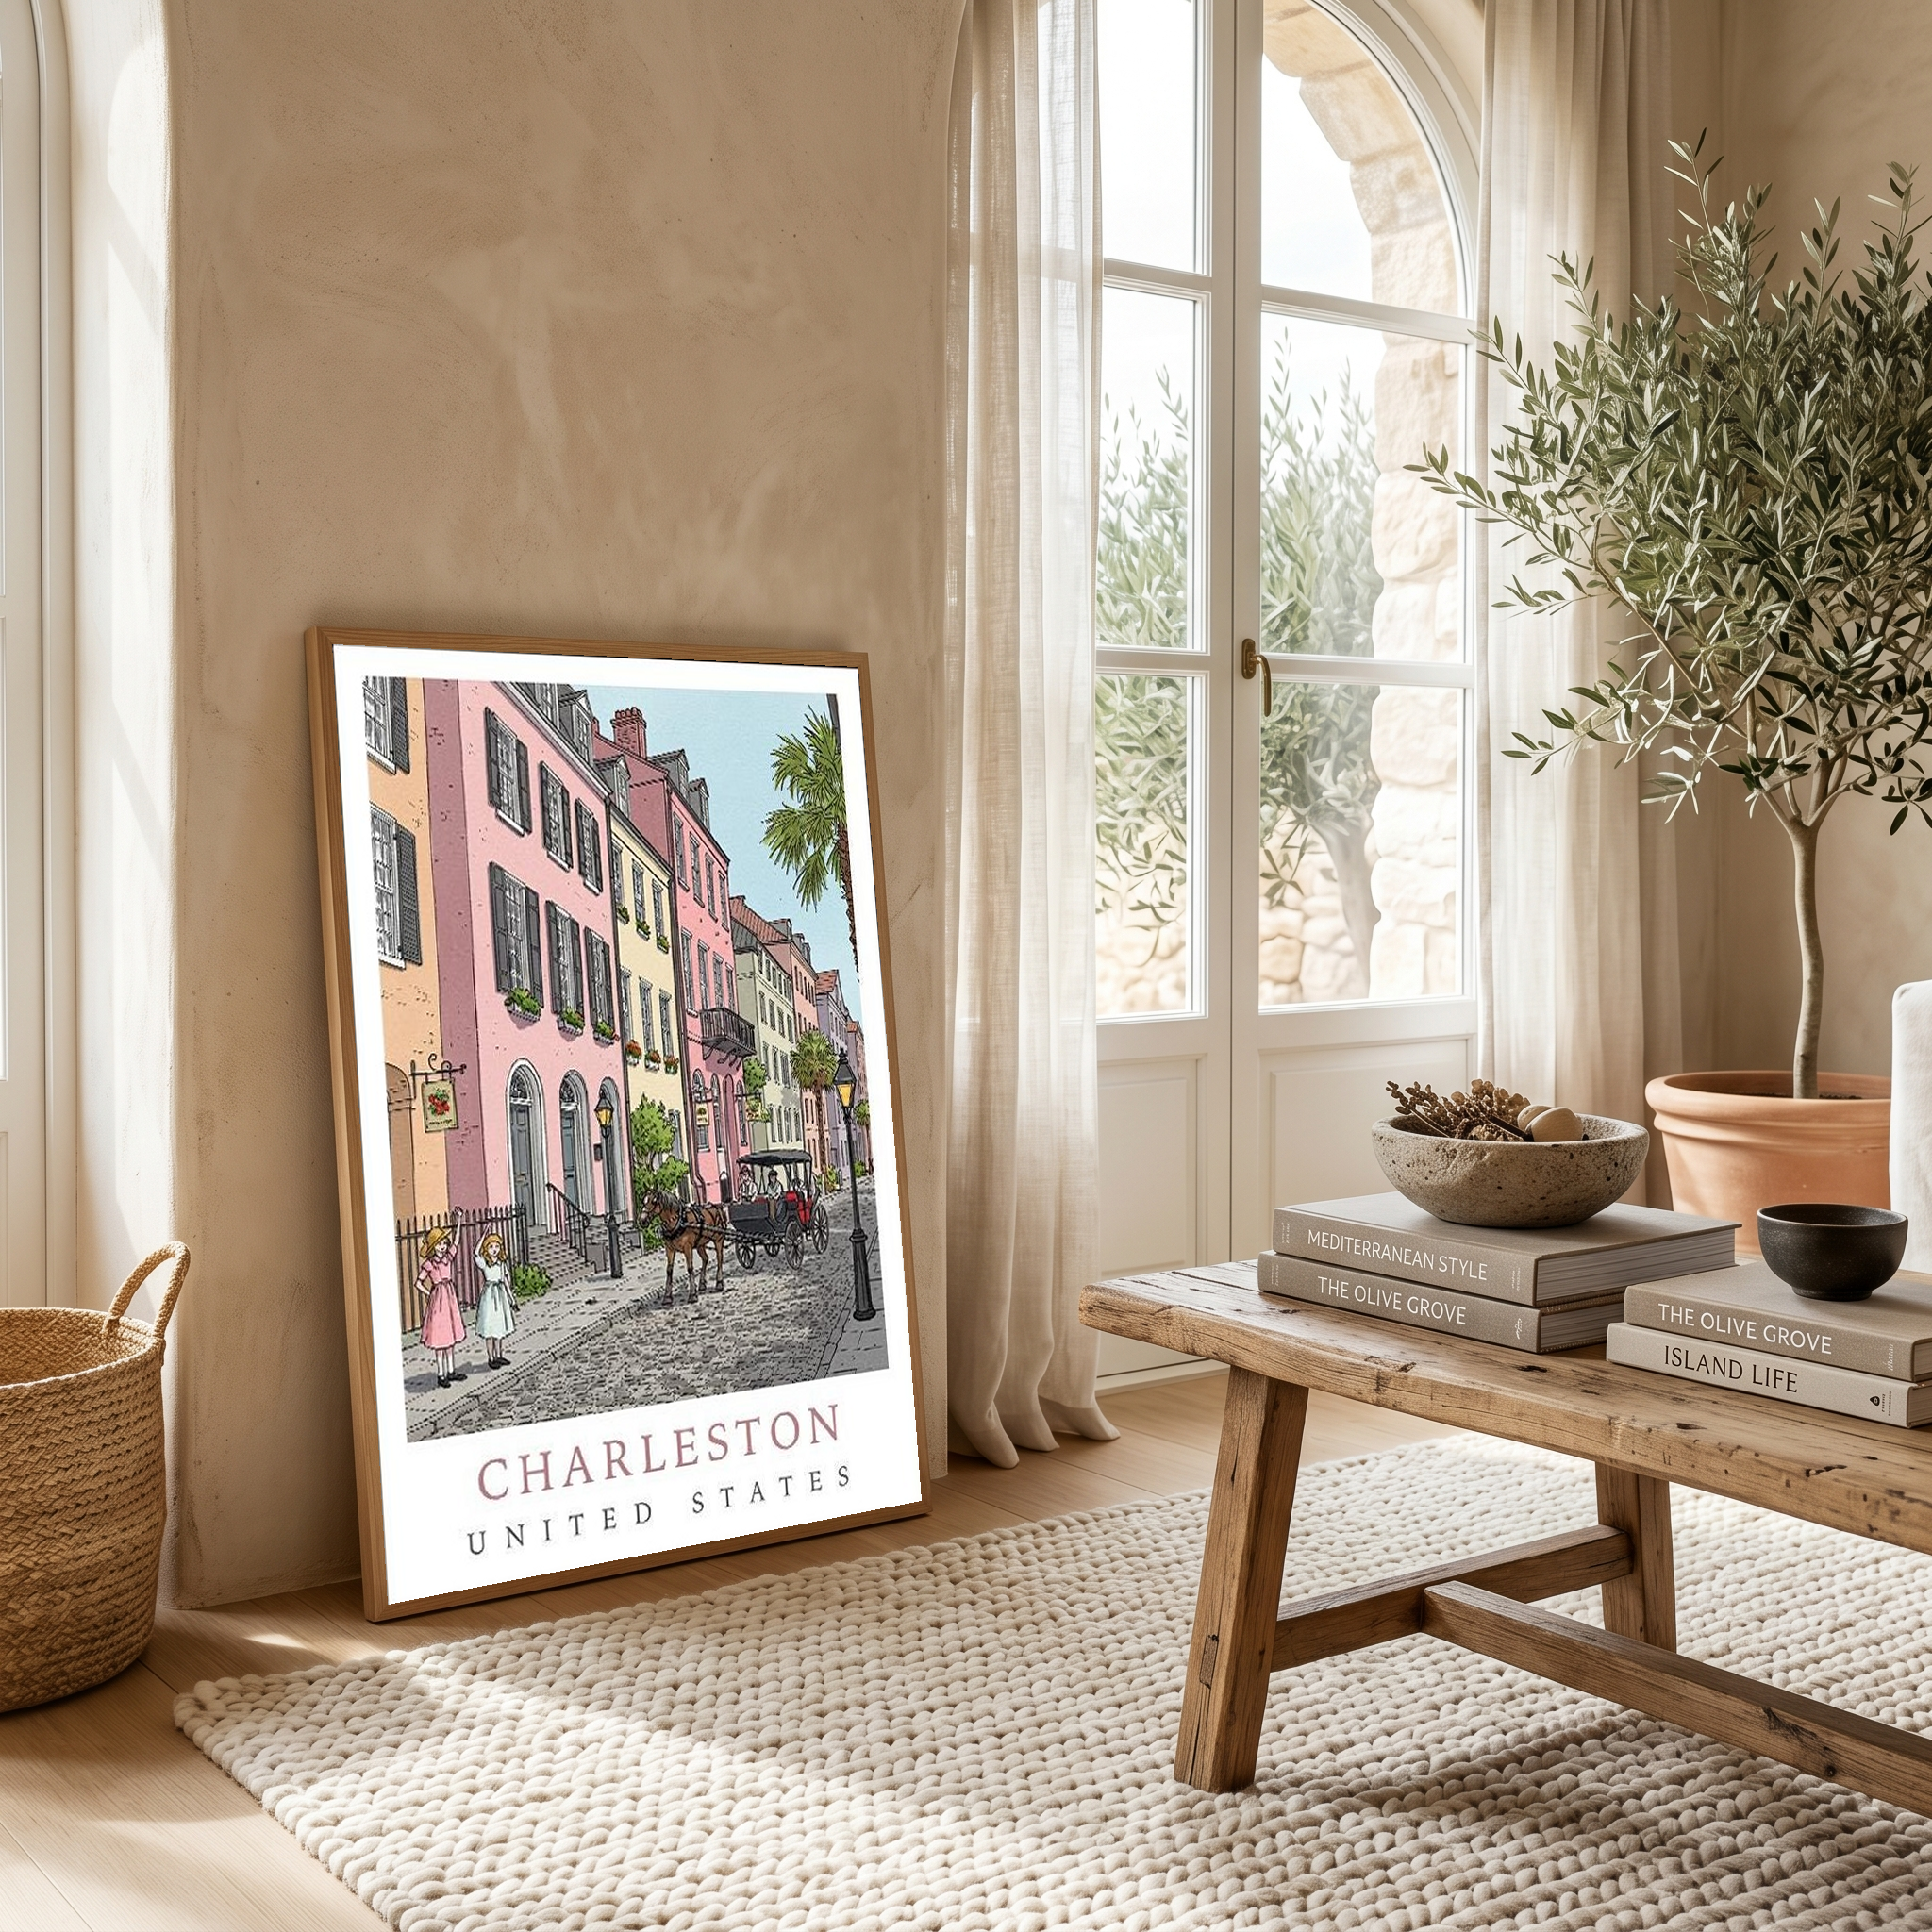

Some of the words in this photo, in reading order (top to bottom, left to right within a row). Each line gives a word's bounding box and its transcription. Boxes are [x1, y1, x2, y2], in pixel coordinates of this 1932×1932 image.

[1307, 1229, 1435, 1271] MEDITERRANEAN
[1438, 1255, 1488, 1281] STYLE
[1318, 1275, 1350, 1299] THE
[1354, 1285, 1402, 1311] OLIVE
[1407, 1296, 1467, 1325] GROVE
[1657, 1303, 1695, 1326] THE
[1700, 1312, 1757, 1340] OLIVE
[1763, 1324, 1832, 1355] GROVE
[1664, 1345, 1743, 1380] ISLAND
[1752, 1364, 1798, 1393] LIFE
[477, 1404, 840, 1501] CHARLESTON
[467, 1501, 653, 1556] UNITED
[691, 1465, 851, 1514] STATES
